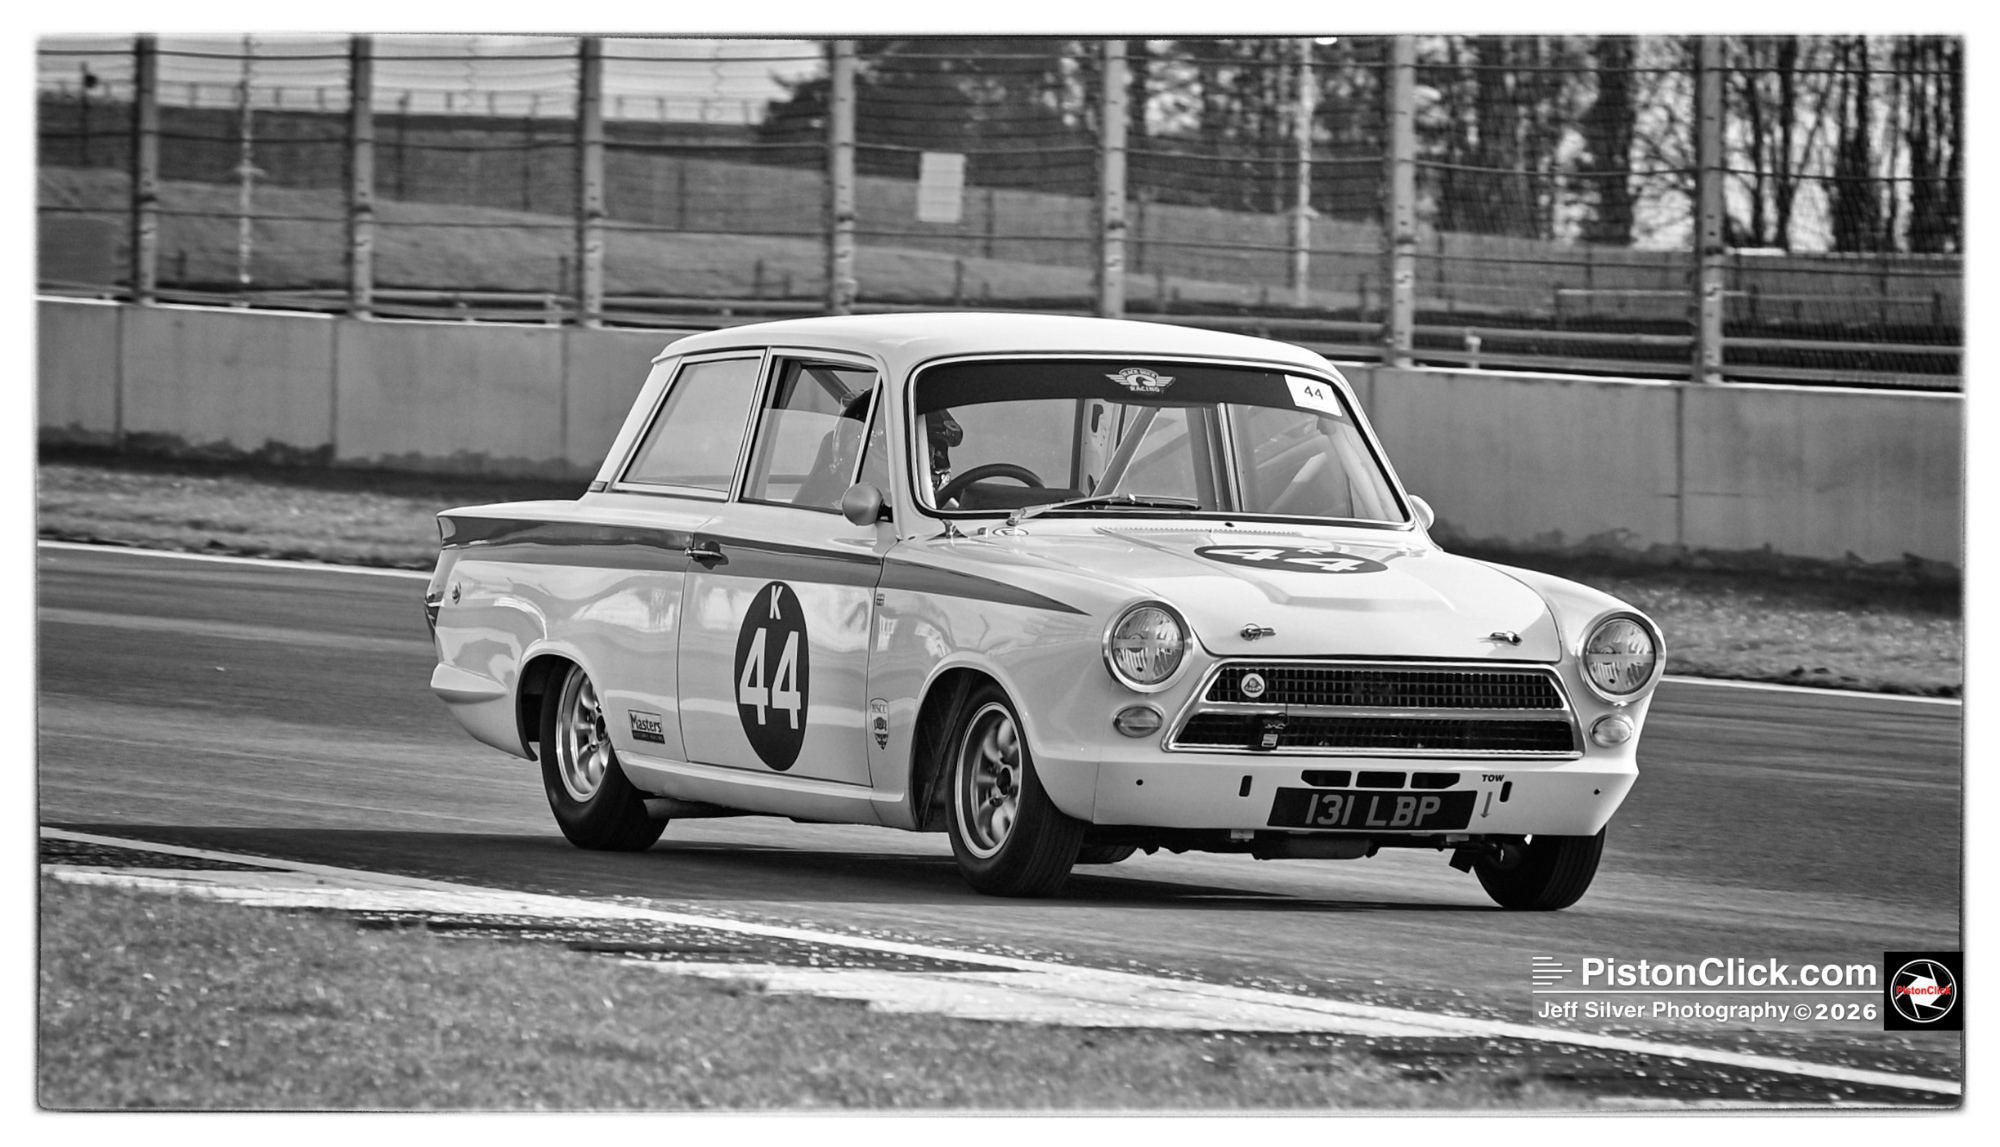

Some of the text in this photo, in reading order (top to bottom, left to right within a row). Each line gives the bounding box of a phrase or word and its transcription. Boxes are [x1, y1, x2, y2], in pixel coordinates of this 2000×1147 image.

[1130, 385, 1160, 393] RACING
[1304, 385, 1324, 400] 44
[1204, 549, 1365, 572] 44
[769, 585, 783, 620] K
[739, 627, 801, 730] 44
[630, 712, 662, 733] Masters
[1482, 774, 1504, 782] TOW
[1305, 794, 1441, 827] 131 LBP
